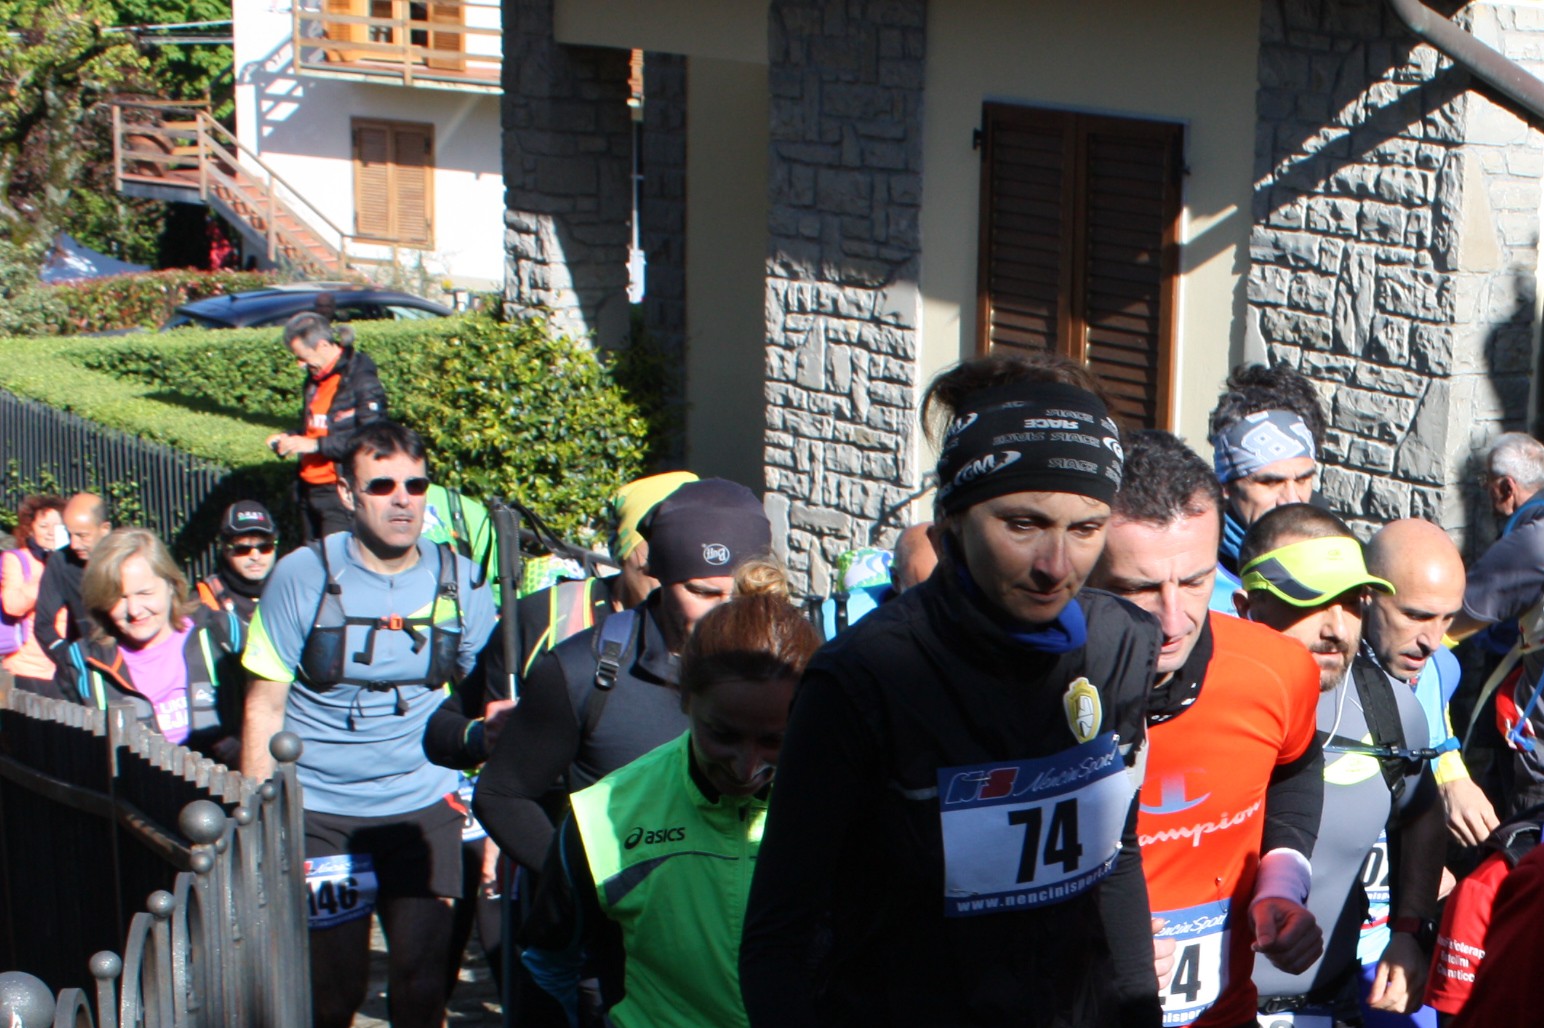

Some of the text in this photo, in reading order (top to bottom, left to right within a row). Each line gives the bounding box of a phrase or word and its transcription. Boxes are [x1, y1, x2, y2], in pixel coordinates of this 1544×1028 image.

[645, 827, 685, 845] asics
[1008, 798, 1082, 884] 74
[1138, 799, 1262, 848] ampion
[1359, 847, 1390, 887] 0
